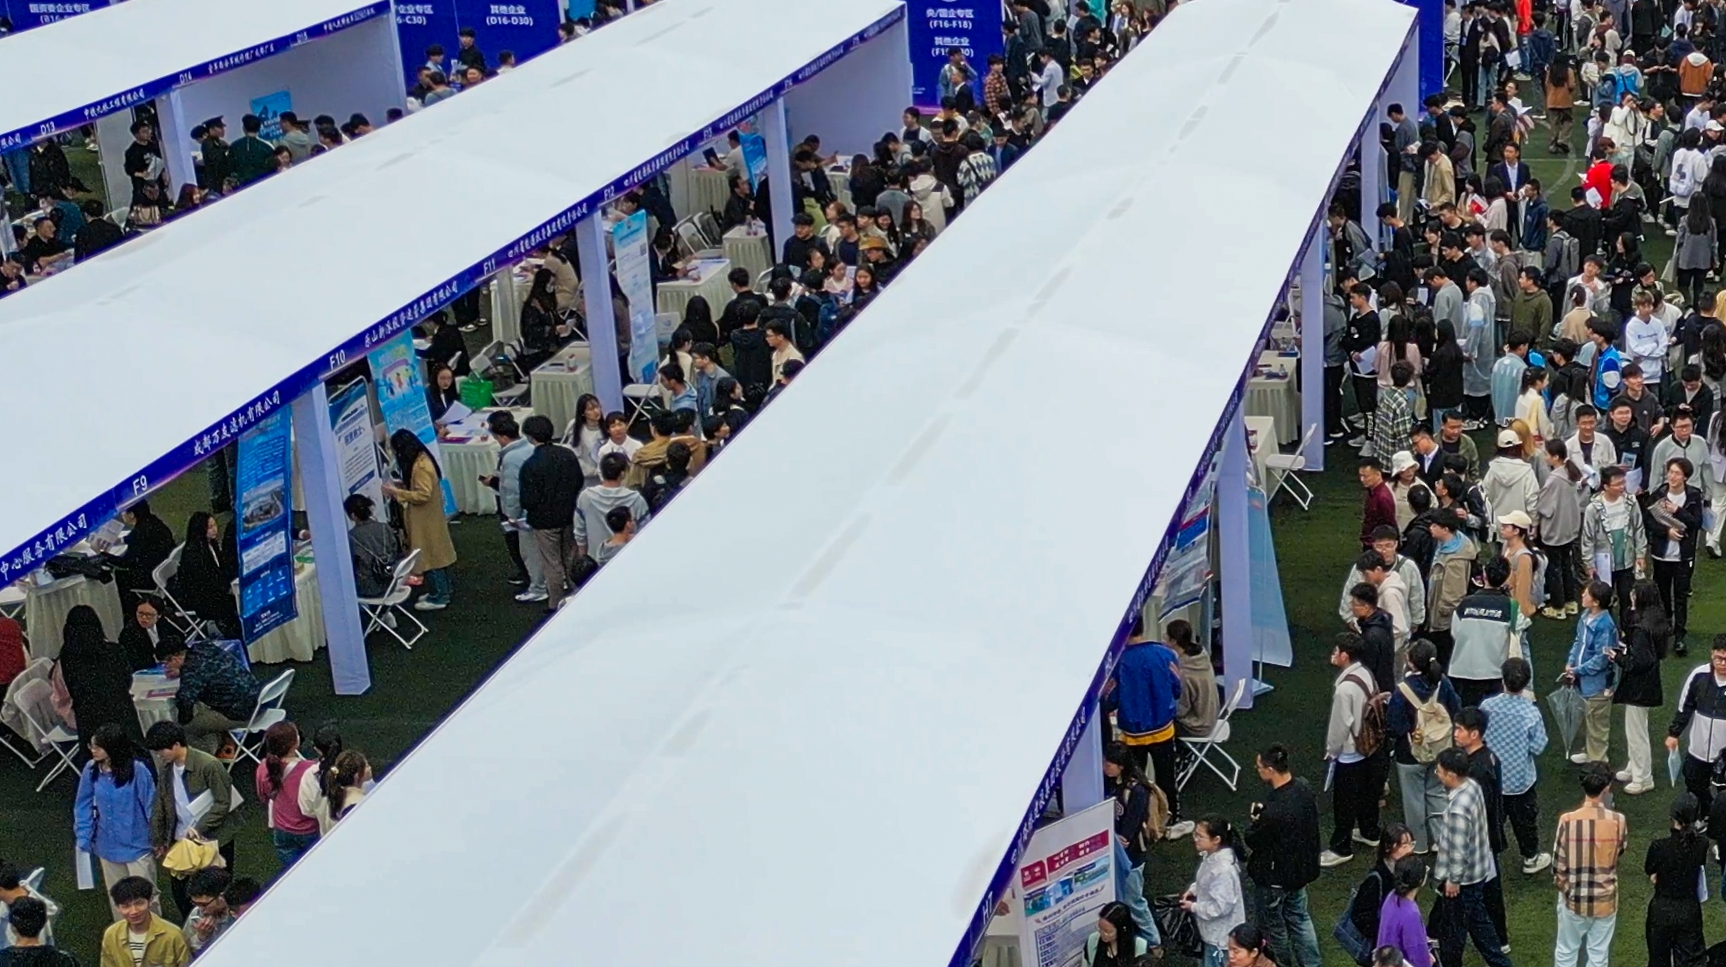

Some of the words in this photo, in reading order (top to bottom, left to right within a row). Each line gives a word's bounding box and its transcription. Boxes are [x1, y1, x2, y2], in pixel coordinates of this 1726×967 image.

[490, 4, 527, 15] 其他企业
[486, 16, 534, 27] (D16-D30)
[929, 20, 973, 30] (F16-F18)
[934, 35, 970, 47] 其他企业
[40, 120, 56, 135] D13
[482, 259, 497, 277] F11
[329, 350, 348, 371] F10
[131, 474, 150, 497] F9
[980, 891, 994, 926] H7
